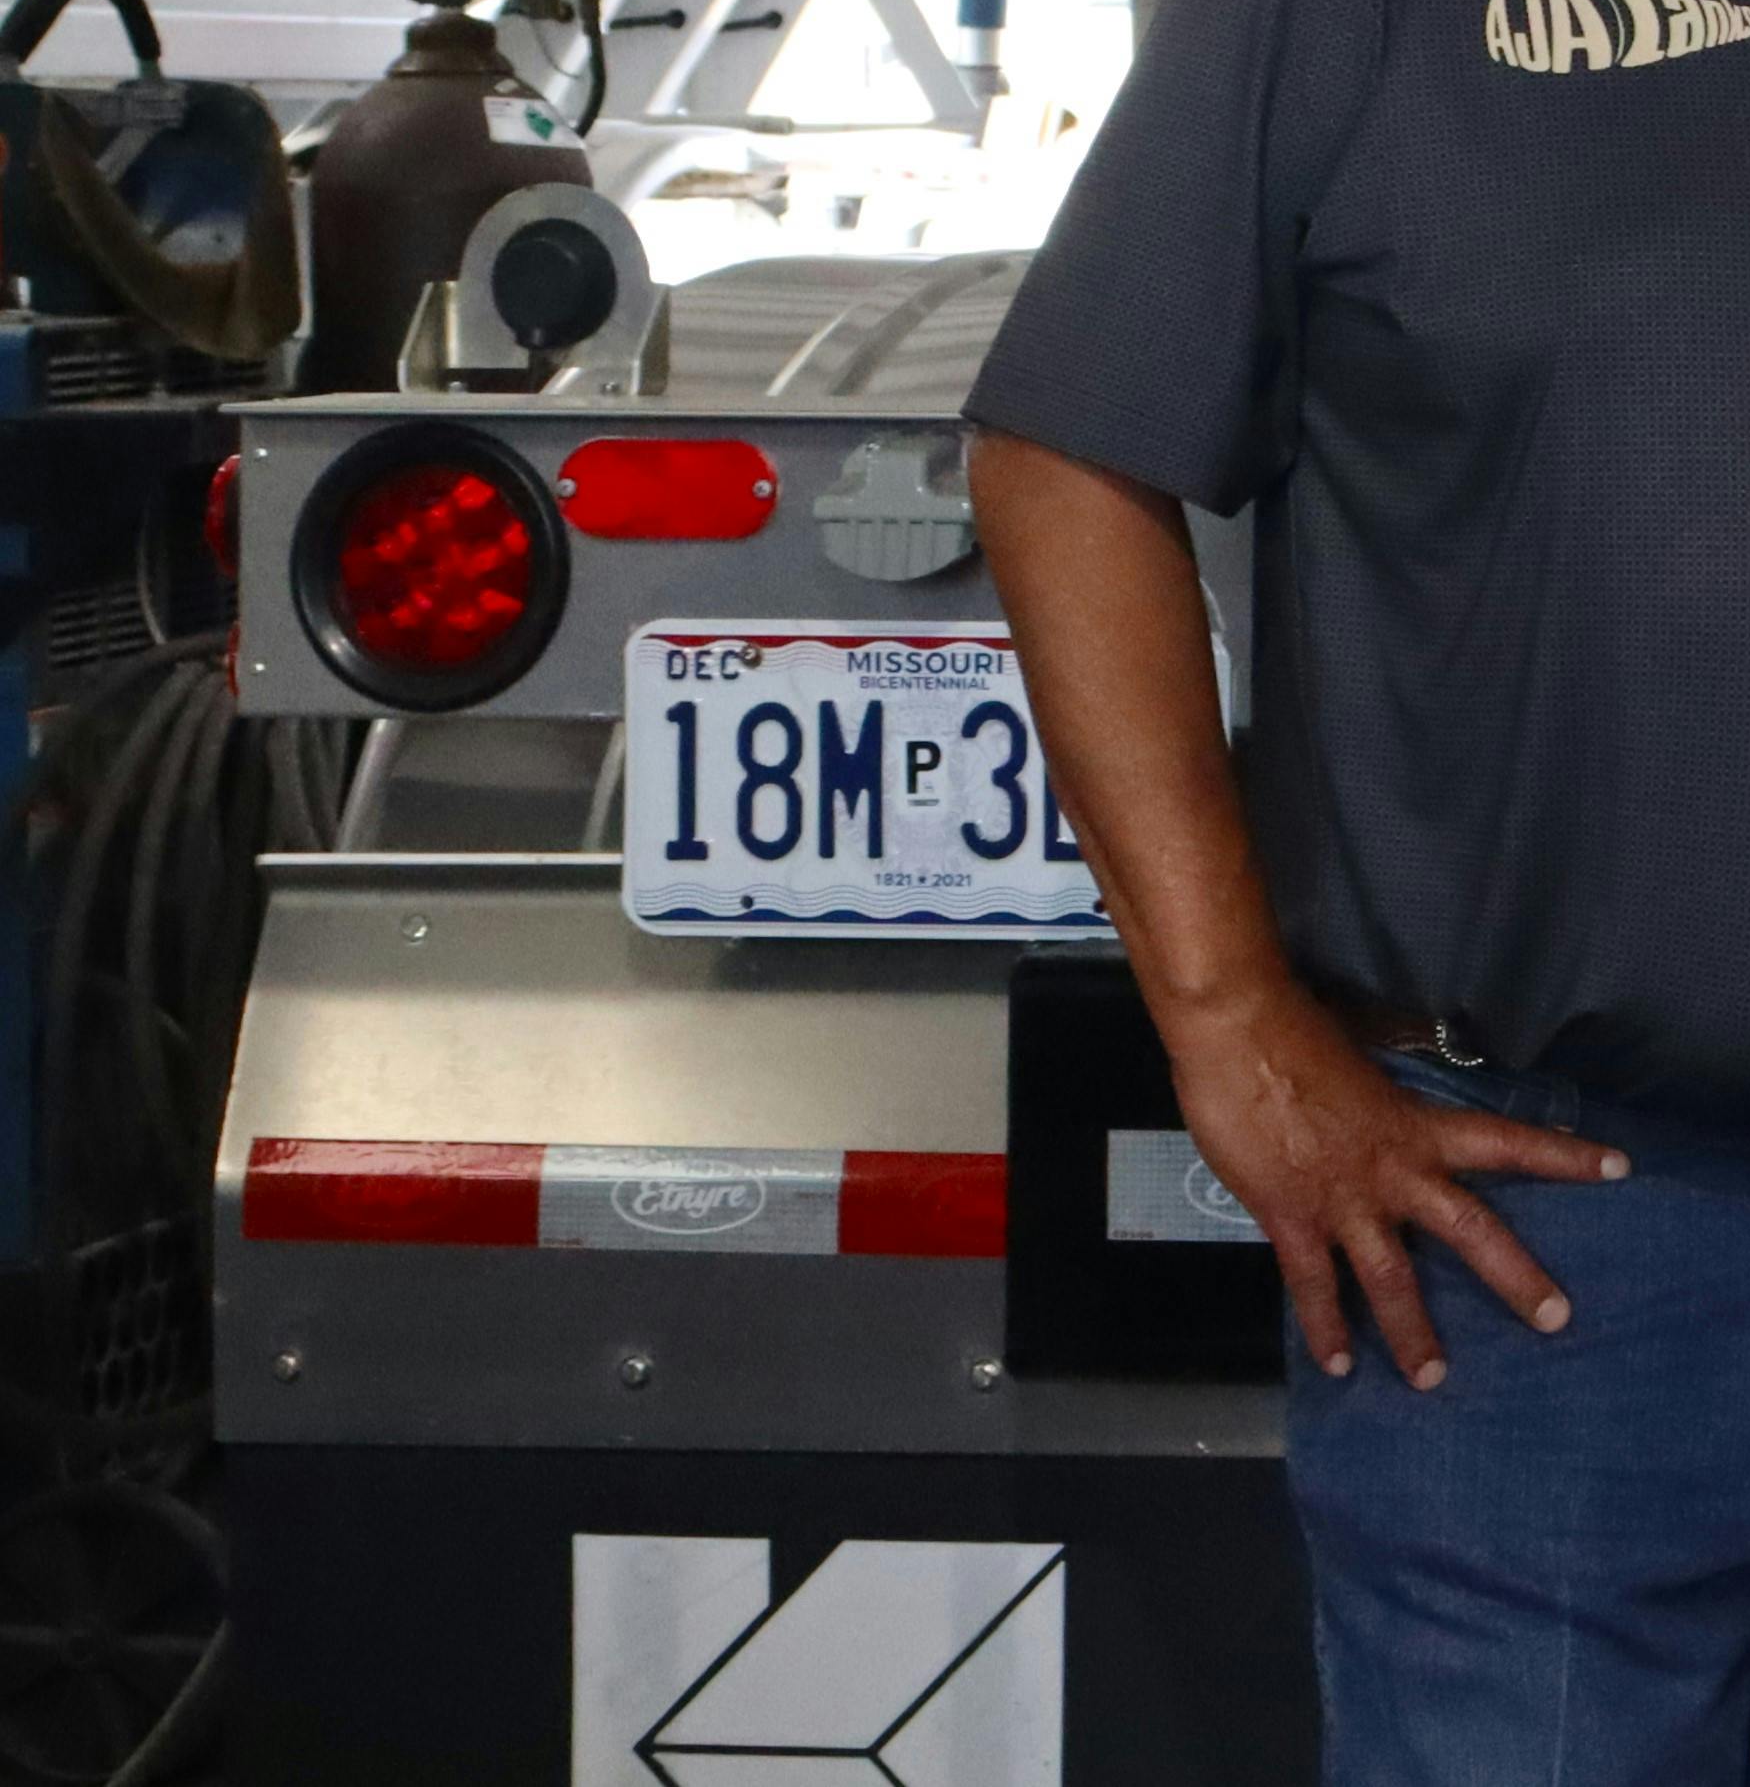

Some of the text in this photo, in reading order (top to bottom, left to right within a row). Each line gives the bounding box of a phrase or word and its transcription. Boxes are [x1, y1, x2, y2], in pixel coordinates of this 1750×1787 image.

[666, 649, 742, 682] DEC
[847, 651, 1004, 676] MISSOURI
[858, 675, 990, 691] BICENTENNIAL
[665, 699, 884, 861] 18M
[906, 740, 942, 795] P
[875, 872, 973, 887] 1821 2021
[632, 1177, 748, 1220] Etnyre
